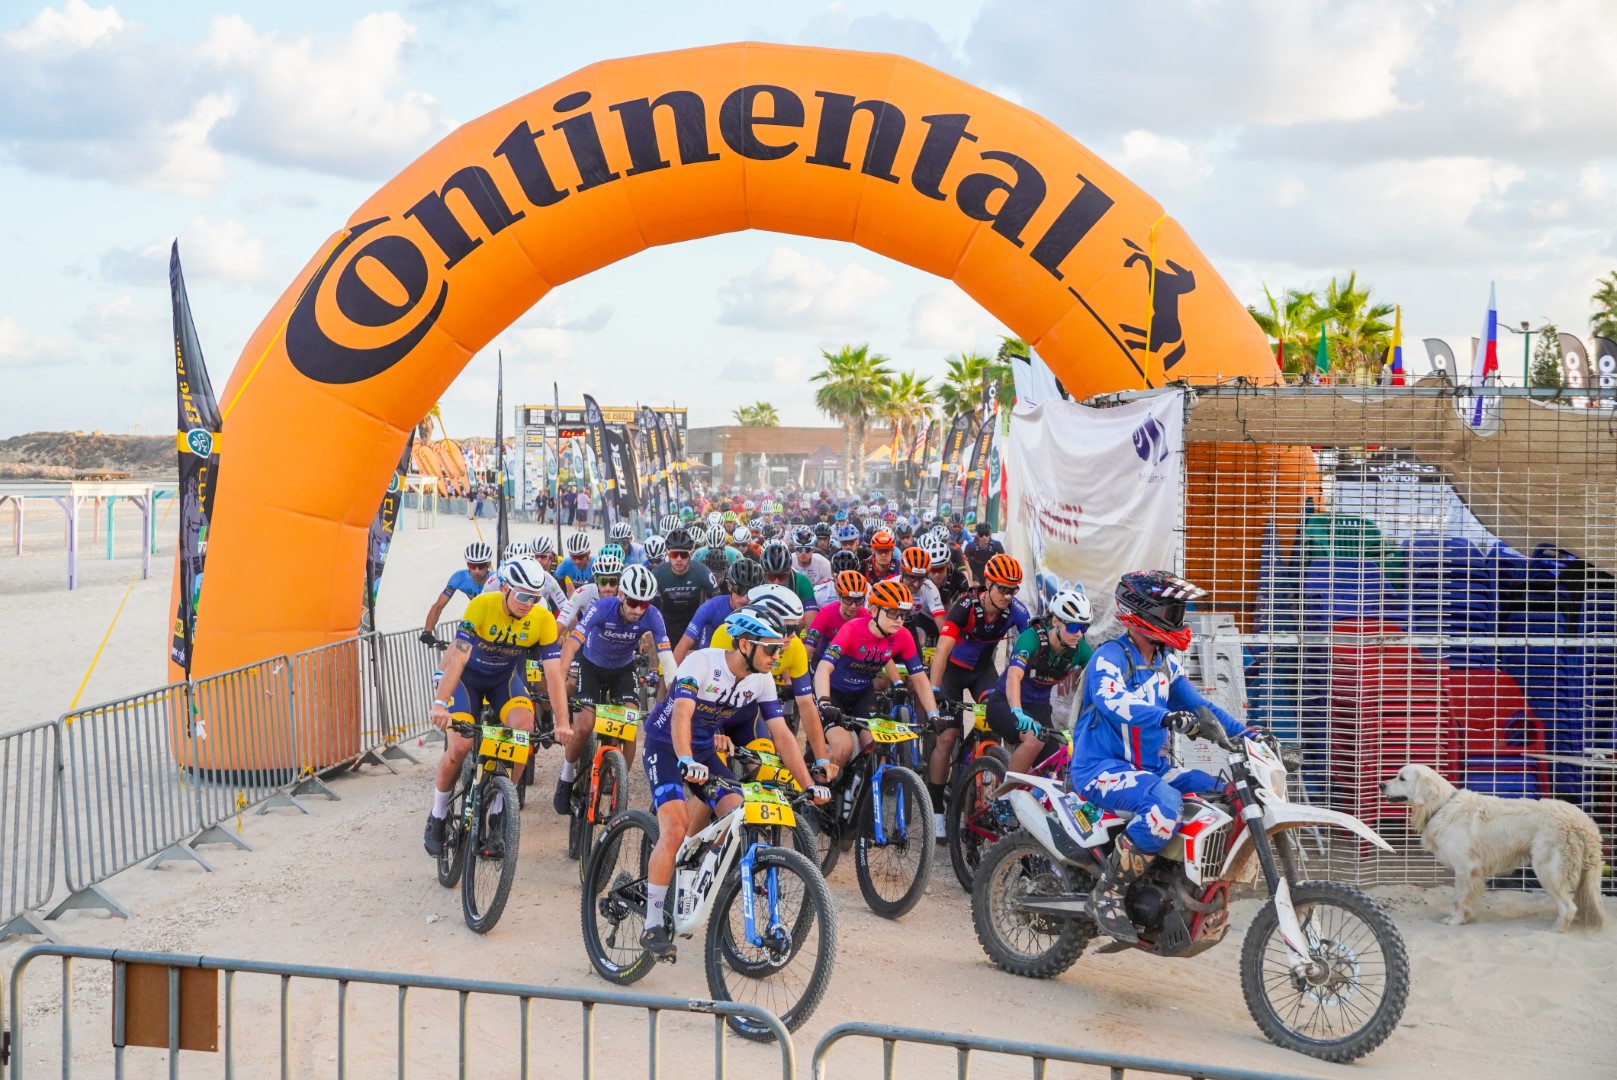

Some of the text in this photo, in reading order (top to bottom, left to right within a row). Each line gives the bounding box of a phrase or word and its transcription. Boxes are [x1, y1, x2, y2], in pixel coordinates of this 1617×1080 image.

[286, 84, 1115, 384] Continental
[180, 382, 201, 423] EPIC
[611, 442, 628, 498] TREK
[581, 605, 598, 626] BeeHi
[603, 629, 637, 640] BeeHi
[734, 617, 767, 635] HJC
[605, 720, 625, 736] 3-1
[494, 742, 515, 758] 1-1
[760, 804, 783, 821] 8-1
[860, 837, 866, 848] DT
[742, 880, 754, 919] SID
